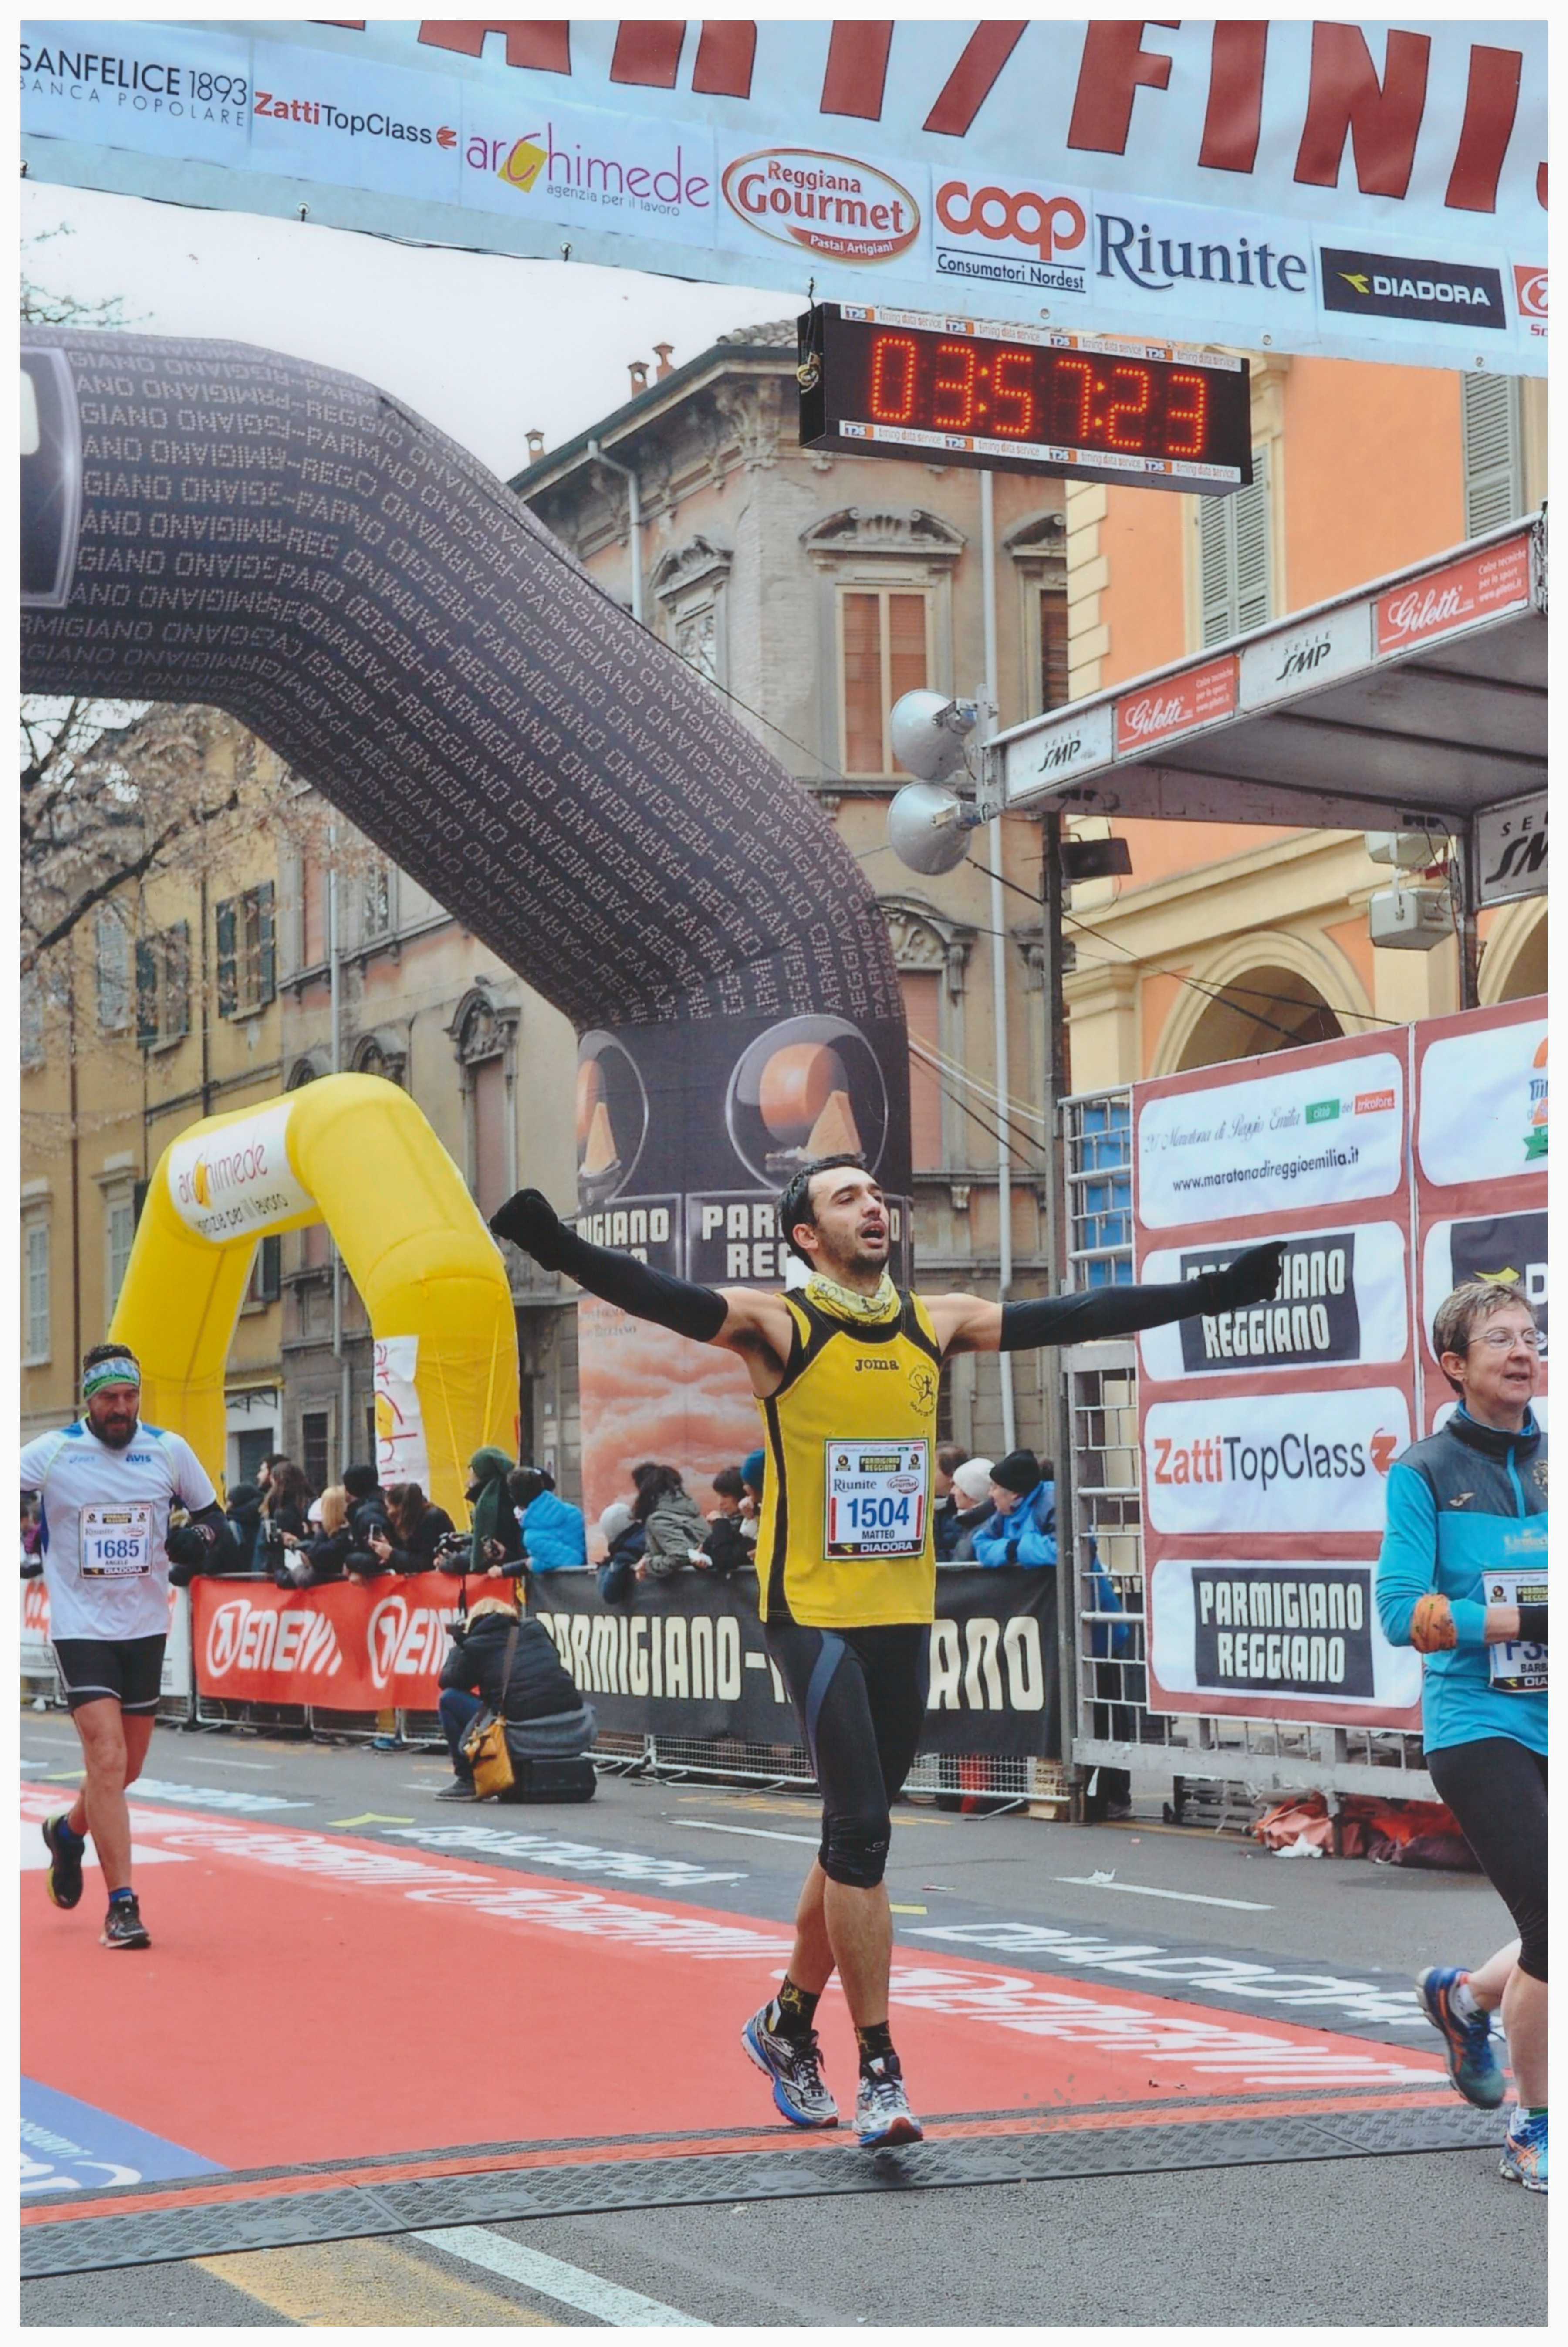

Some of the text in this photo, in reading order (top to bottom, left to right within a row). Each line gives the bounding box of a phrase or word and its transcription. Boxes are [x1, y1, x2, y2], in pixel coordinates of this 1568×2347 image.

[20, 44, 247, 107] SANFELICE 1893
[118, 93, 245, 127] POPOLARE
[768, 160, 862, 194] Reggiana
[547, 184, 680, 216] agenzia per il lavoro
[738, 173, 904, 234] Gourmet
[936, 181, 1086, 262] coop
[810, 235, 893, 255] Pastai Artigiani
[1095, 213, 1308, 294] Riunite
[938, 253, 1084, 289] Consumatori Nordest
[1373, 275, 1491, 308] DIADORA
[902, 313, 916, 325] data
[918, 315, 941, 328] service
[1002, 326, 1015, 338] data
[1017, 328, 1040, 342] service
[1105, 340, 1118, 352] data
[1119, 342, 1141, 355] service
[1199, 353, 1212, 365] data
[1213, 355, 1236, 367] service
[872, 336, 1206, 456] 03:57:23
[901, 429, 916, 441] data
[918, 431, 941, 445] service
[1001, 443, 1015, 454] data
[1017, 443, 1039, 457] service
[1103, 454, 1117, 466] data
[1119, 456, 1141, 469] service
[1198, 466, 1212, 477] data
[1213, 467, 1234, 479] service
[1276, 642, 1331, 682] SMP
[1038, 739, 1081, 773] SMP
[1173, 1146, 1360, 1192] www.maratonadireggioemilia.it
[1203, 1304, 1330, 1358] REGGIANO
[833, 1478, 877, 1493] Riunite
[847, 1496, 909, 1528] 1504
[94, 1539, 139, 1559] 1685
[860, 1541, 913, 1553] DIADORA
[862, 1529, 895, 1540] MATTEO
[1199, 1581, 1363, 1630] PARMIGIANO
[1217, 1632, 1345, 1682] REGGIANO
